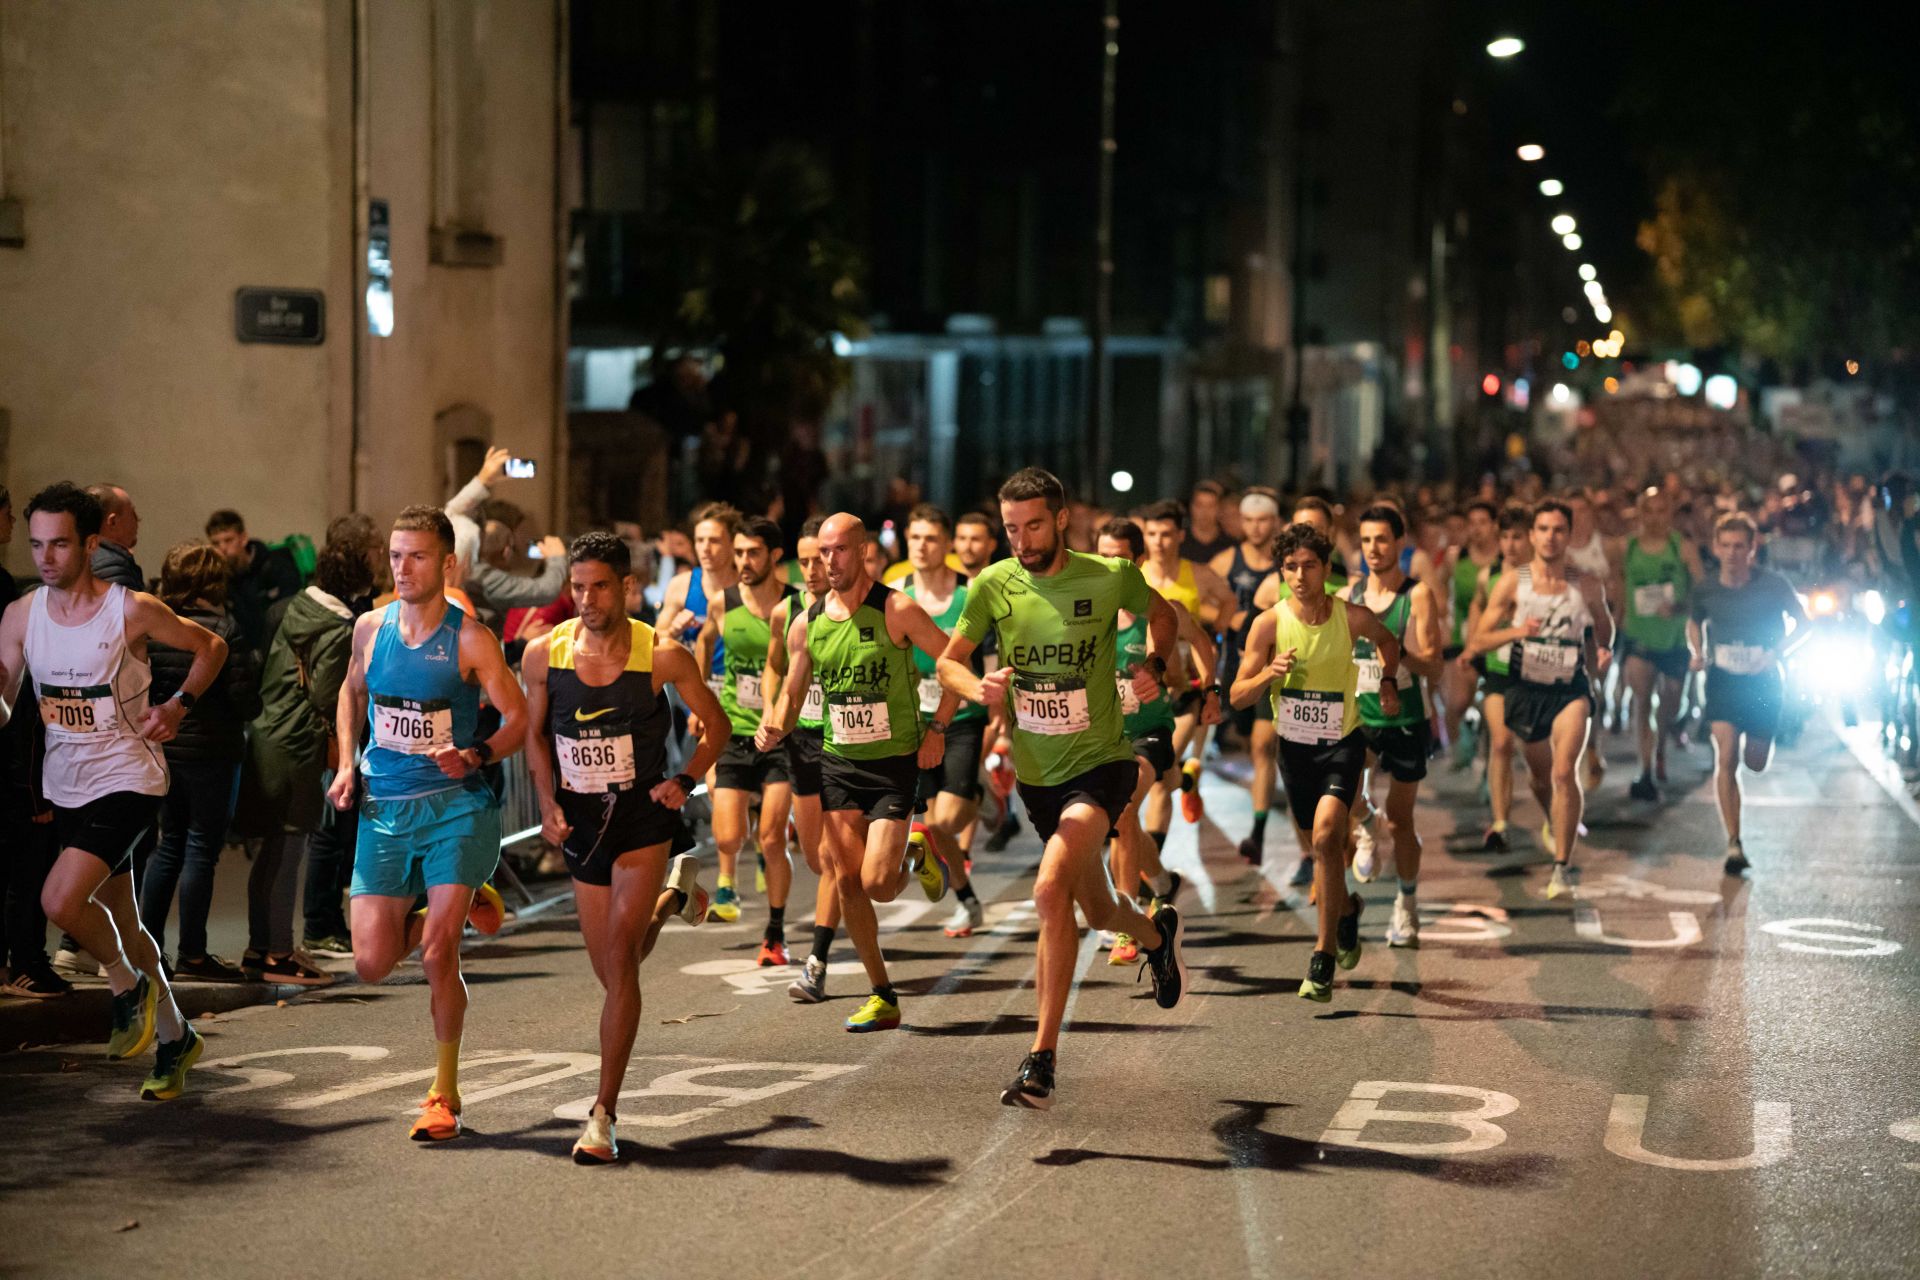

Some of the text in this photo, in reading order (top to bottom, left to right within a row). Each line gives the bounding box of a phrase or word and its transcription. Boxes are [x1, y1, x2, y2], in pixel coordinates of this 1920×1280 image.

[1013, 643, 1073, 666] EAPB
[1365, 664, 1381, 680] 70
[62, 689, 82, 697] 10 KM
[1035, 682, 1056, 691] 10 KM
[402, 699, 422, 710] 10 KM
[808, 690, 820, 706] 70
[55, 705, 95, 726] 7019
[1027, 698, 1070, 719] 7065
[1293, 704, 1329, 724] 8635
[390, 715, 434, 739] 7066
[839, 710, 874, 729] 7042
[578, 729, 602, 738] 10 KM
[571, 745, 615, 767] 8636
[1316, 1080, 1920, 1173] BU
